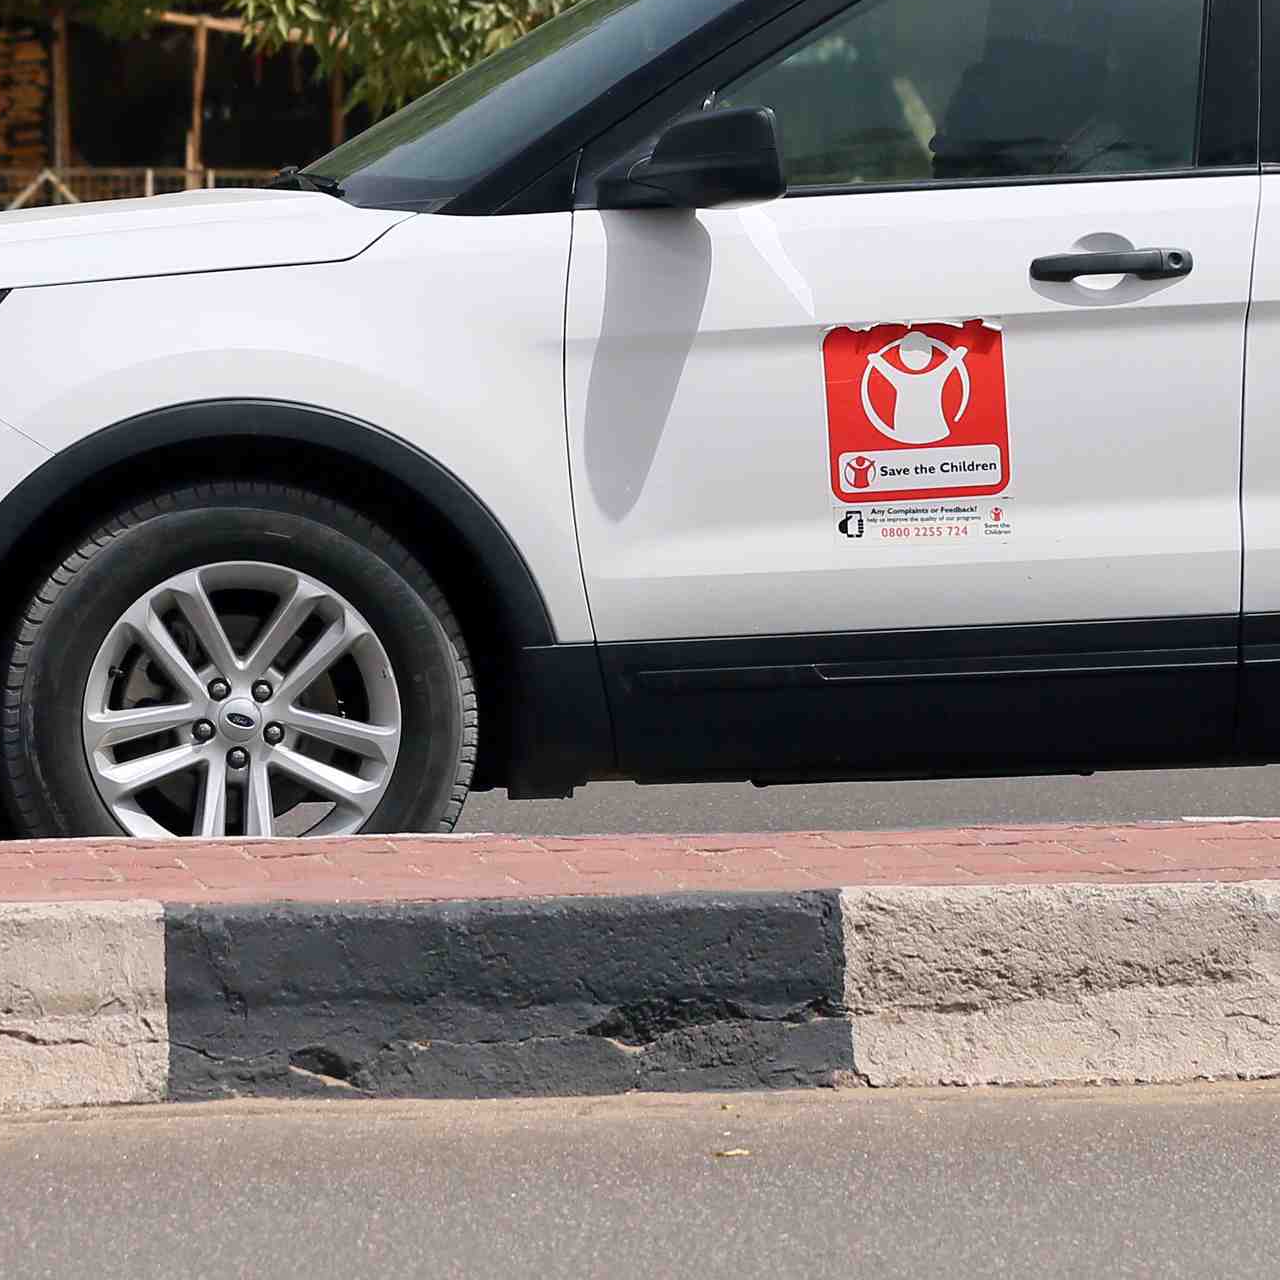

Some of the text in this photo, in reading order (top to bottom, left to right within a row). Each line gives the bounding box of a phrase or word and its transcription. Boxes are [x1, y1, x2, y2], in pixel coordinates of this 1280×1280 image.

[880, 461, 997, 477] Save the Children
[871, 508, 886, 517] Any
[887, 507, 929, 516] Complaints
[881, 526, 968, 538] 0800 2255 724
